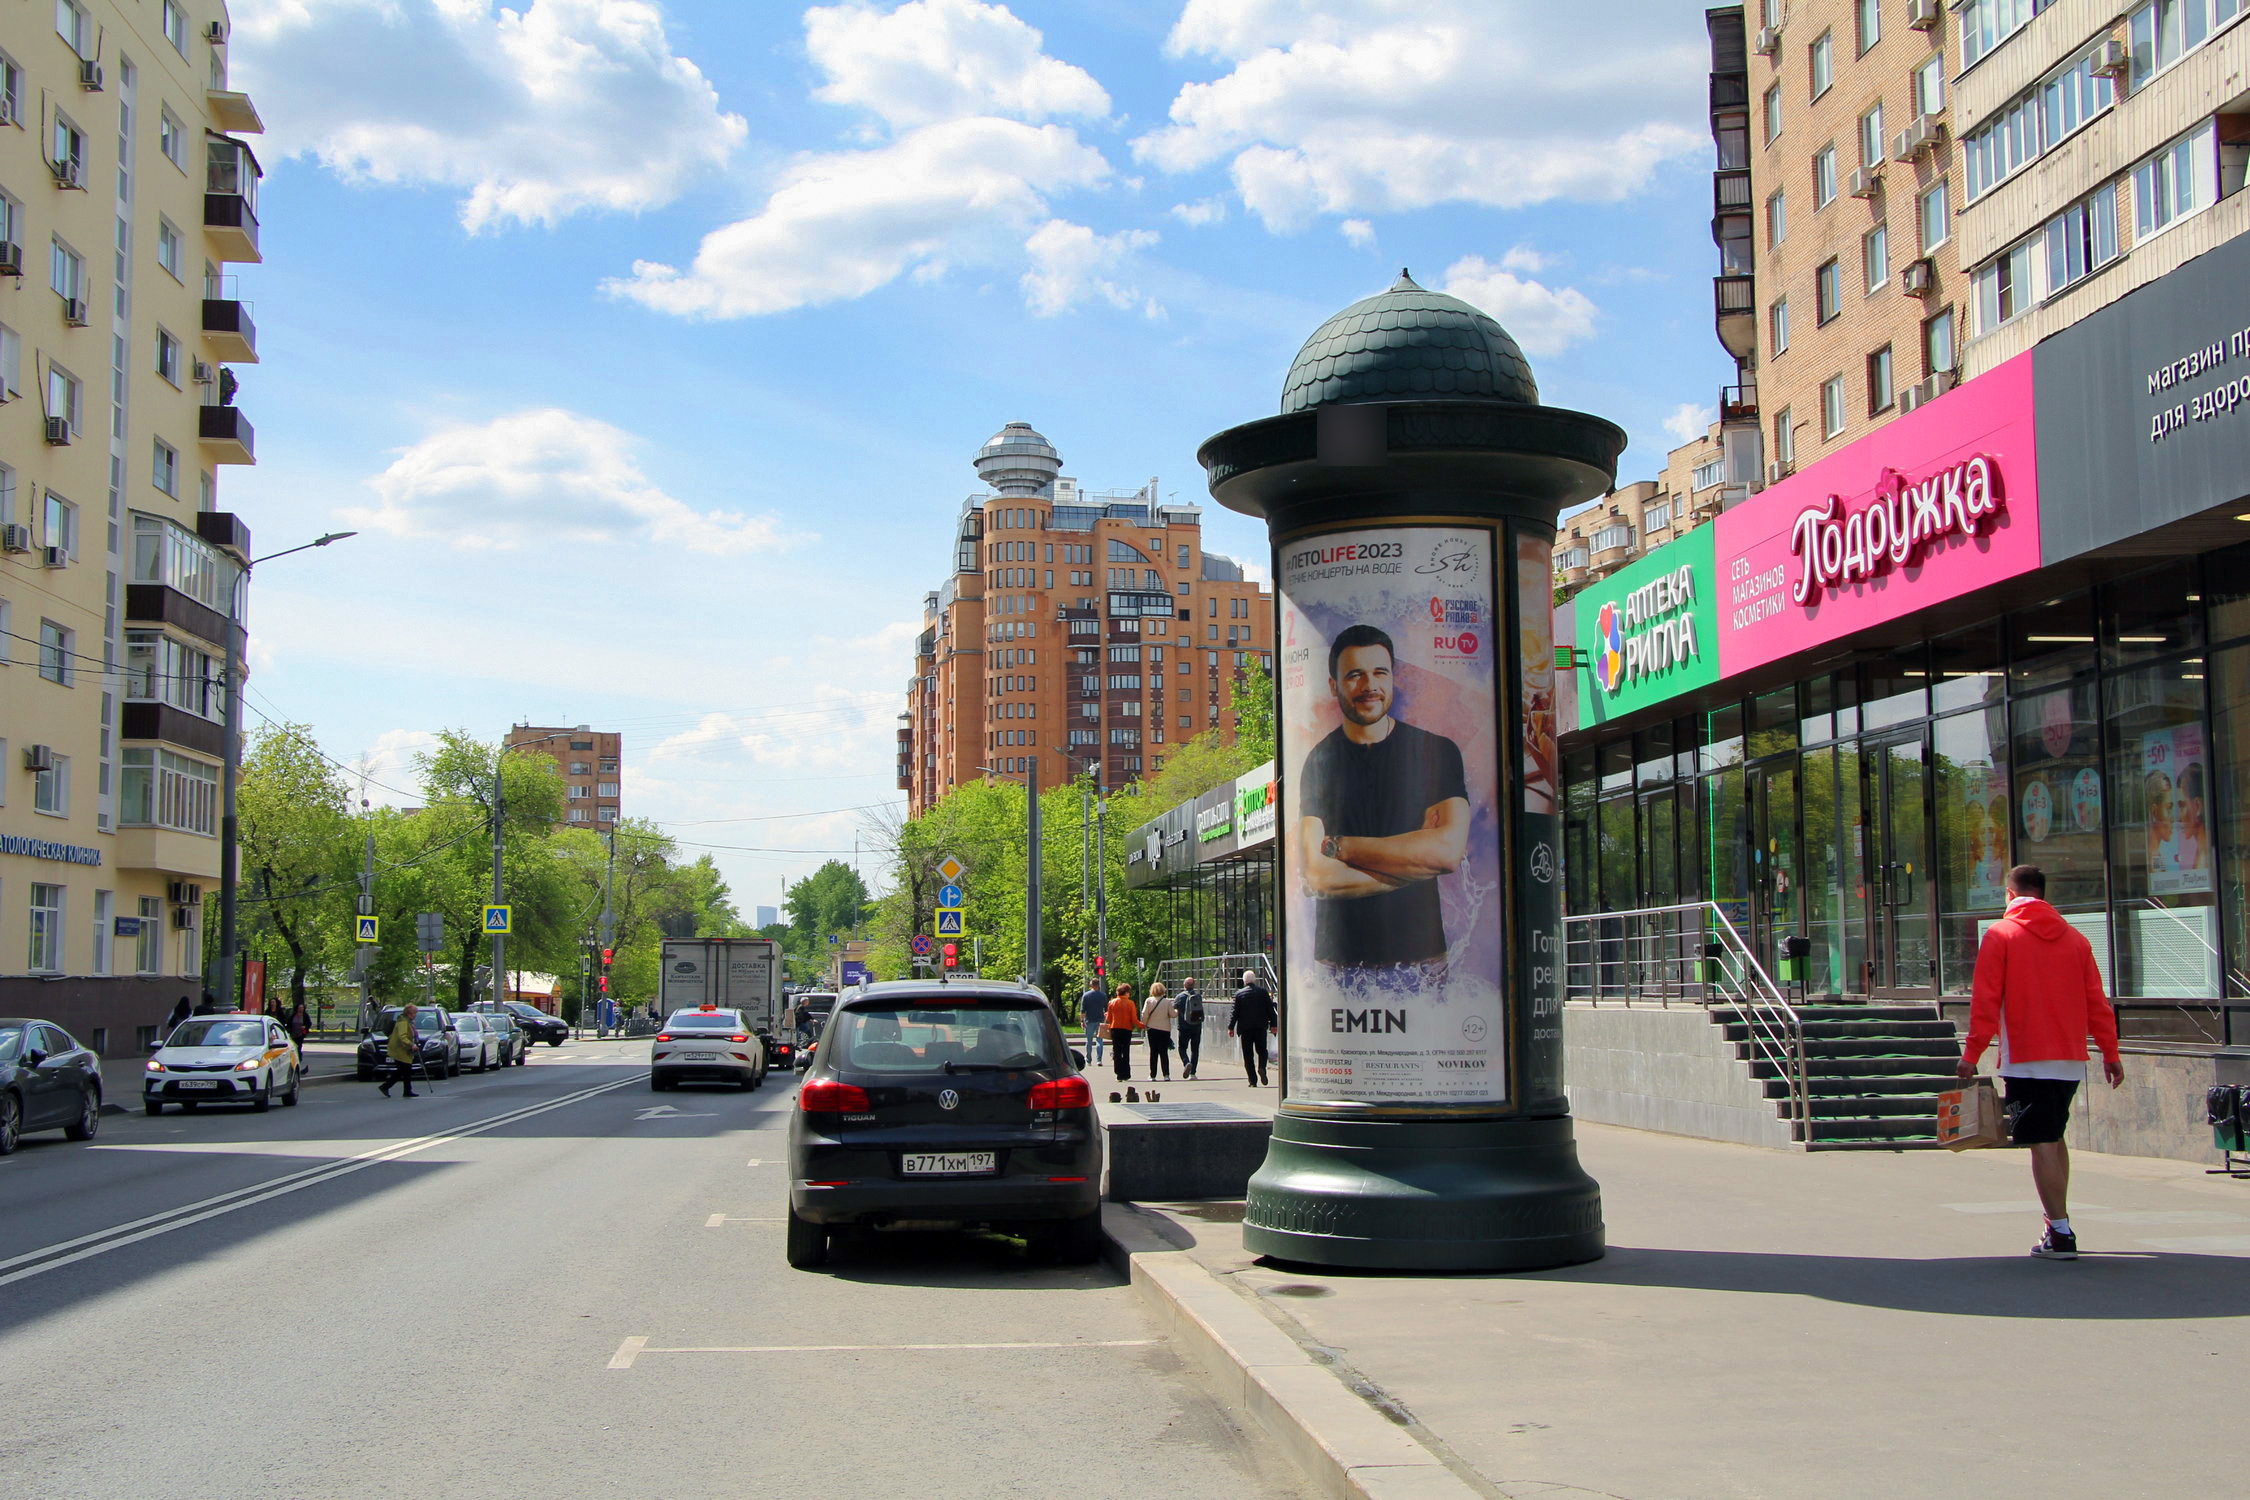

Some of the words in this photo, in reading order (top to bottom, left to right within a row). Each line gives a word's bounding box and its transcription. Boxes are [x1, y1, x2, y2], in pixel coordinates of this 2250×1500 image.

[2147, 340, 2224, 395] магазин
[2150, 403, 2186, 442] для
[1791, 452, 1996, 605] Подружка
[1307, 565, 1354, 582] КОНЦЕРТЫ
[1355, 564, 1370, 576] НА
[1372, 562, 1402, 575] ВОДЕ
[1731, 556, 1749, 581] СЕТЬ
[1732, 564, 1785, 607] МАГАЗИНОВ
[1625, 563, 1695, 628] АПТЕКА
[1732, 591, 1786, 632] КОСМЕТИКИ
[1625, 612, 1699, 681] РИГЛА
[1331, 1008, 1407, 1034] EMIN
[1437, 1060, 1487, 1069] NOVIKOV
[906, 1156, 966, 1172] В771ХМ
[969, 1154, 992, 1166] 197
